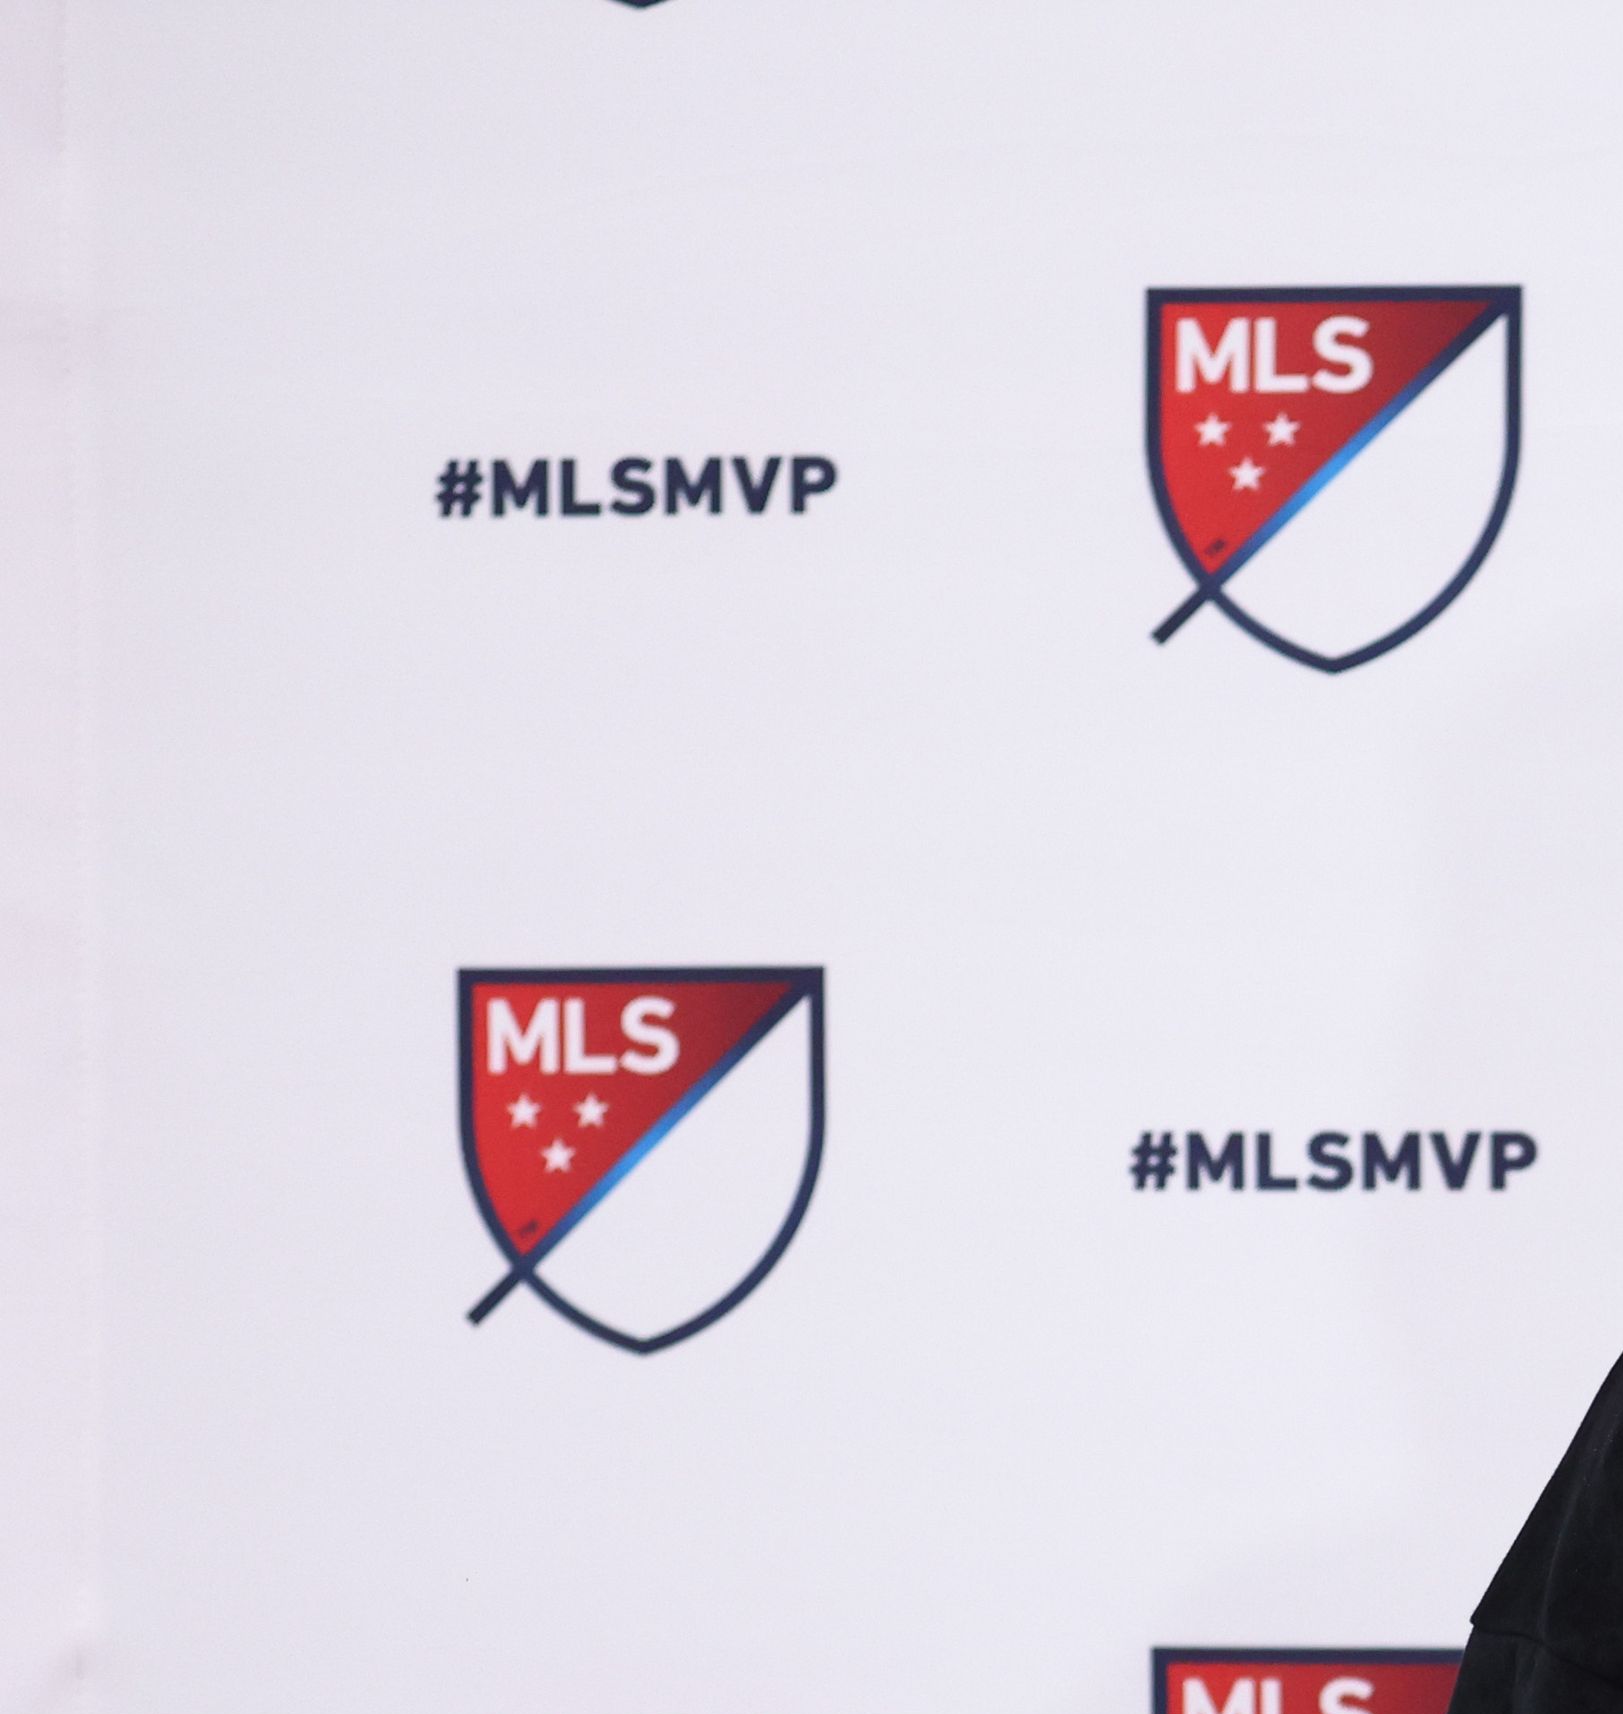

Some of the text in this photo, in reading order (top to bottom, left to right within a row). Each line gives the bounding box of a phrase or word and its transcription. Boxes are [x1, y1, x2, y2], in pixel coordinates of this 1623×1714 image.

[1175, 315, 1374, 394] MLS
[435, 455, 838, 519] #MLSMVP
[486, 996, 680, 1075] MLS
[1129, 1130, 1539, 1193] #MLSMVP
